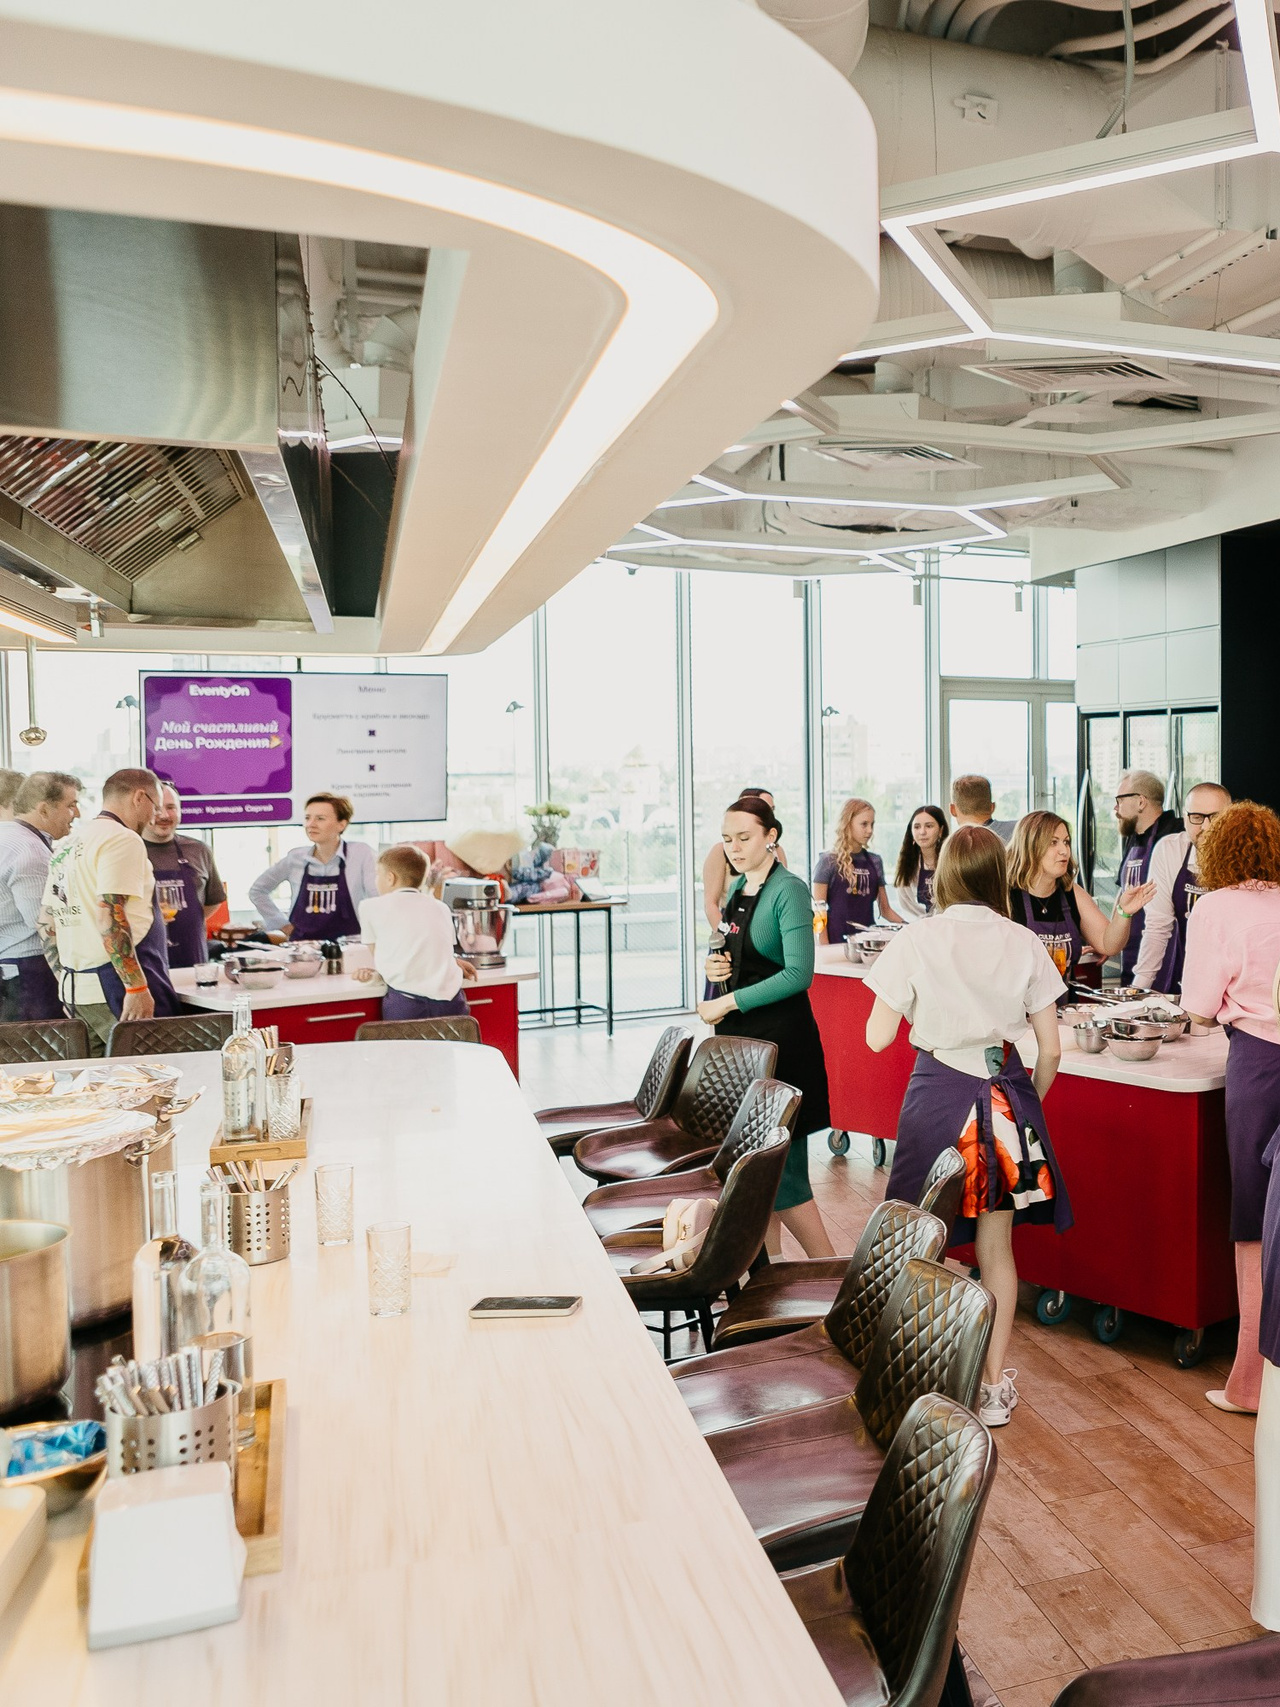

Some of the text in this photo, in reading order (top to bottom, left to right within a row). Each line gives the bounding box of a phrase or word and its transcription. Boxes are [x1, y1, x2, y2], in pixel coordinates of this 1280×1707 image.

[188, 684, 250, 698] EventyOn
[161, 720, 279, 733] Мой счастливый
[154, 736, 270, 751] День Рождения
